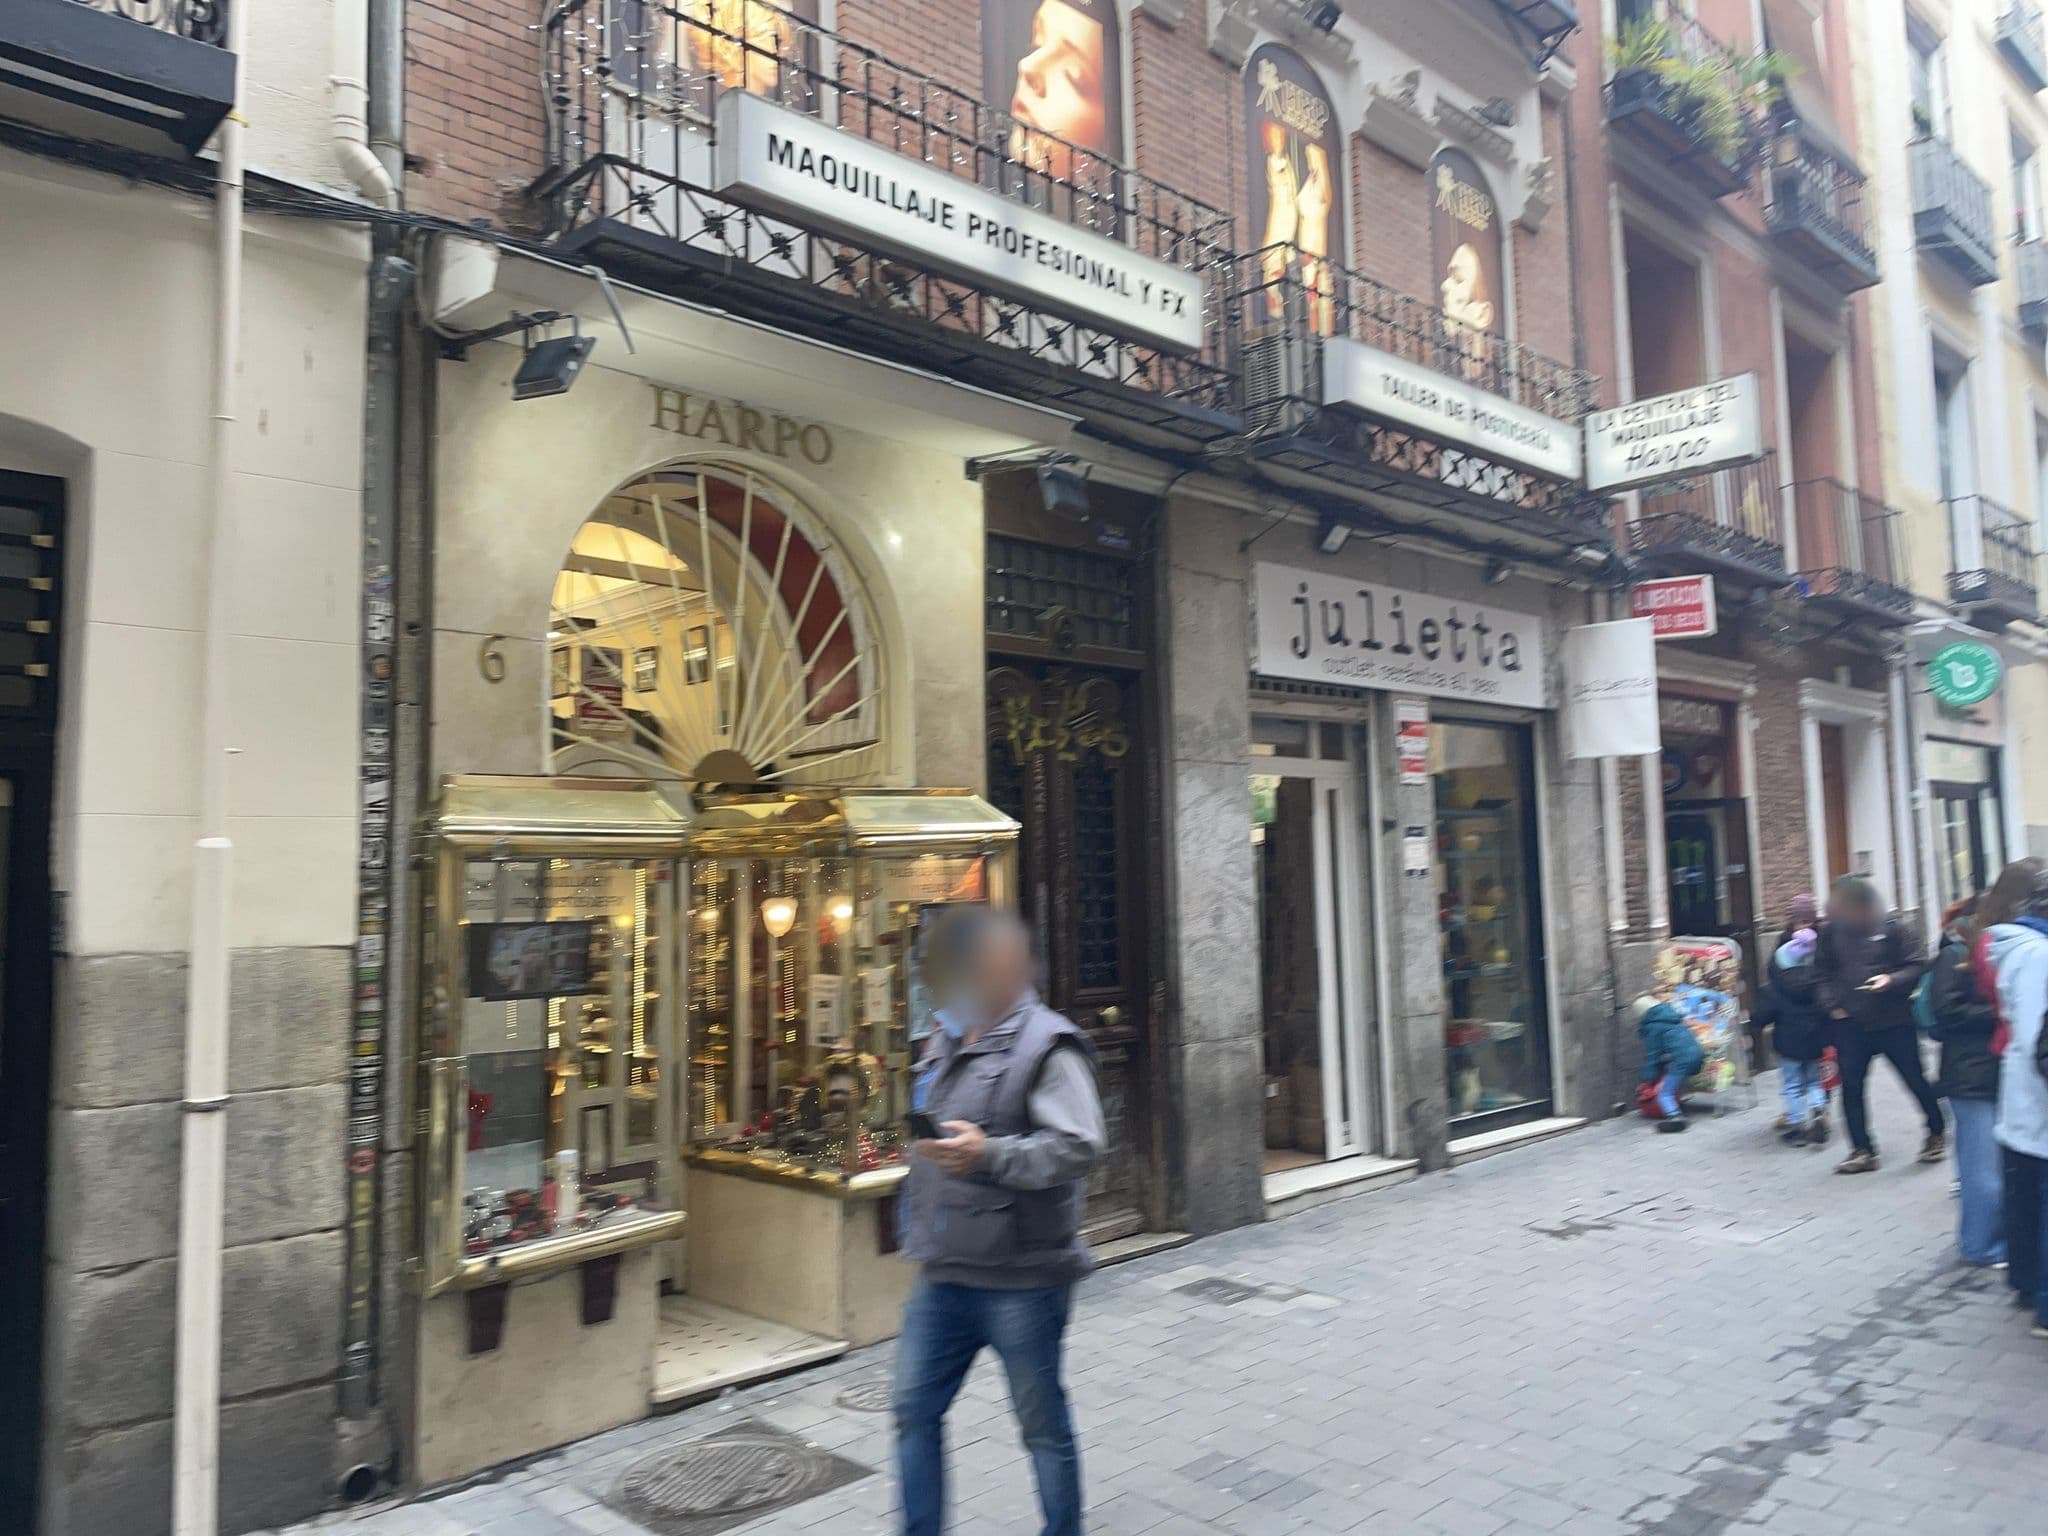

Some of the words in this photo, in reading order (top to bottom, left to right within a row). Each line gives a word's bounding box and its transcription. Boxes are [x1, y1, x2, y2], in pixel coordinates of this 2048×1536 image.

[766, 132, 956, 232] MAQUILLAJE
[968, 212, 1130, 301] PROFESIONAL
[1137, 279, 1151, 305] Y
[1157, 290, 1189, 319] FX
[648, 383, 834, 466] HARPO
[1612, 405, 1724, 447] MAQUILLAJE
[477, 634, 507, 684] 6
[1290, 581, 1522, 673] julietta
